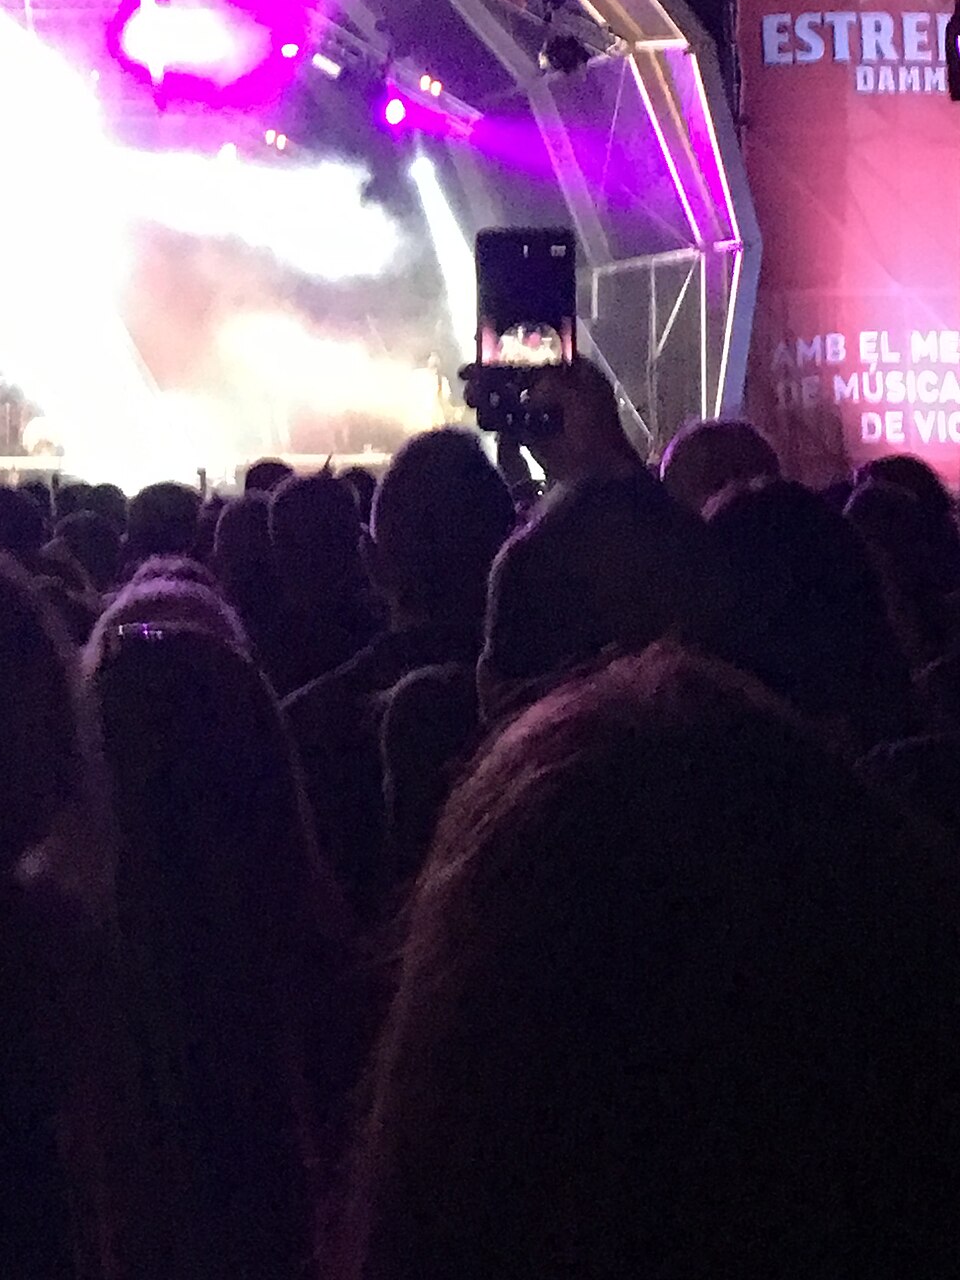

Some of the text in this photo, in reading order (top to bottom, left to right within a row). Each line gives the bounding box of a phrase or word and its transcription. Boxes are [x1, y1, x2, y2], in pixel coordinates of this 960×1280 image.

[856, 65, 947, 93] DAMM
[771, 329, 960, 369] AMB EL ME
[861, 410, 905, 444] DE
